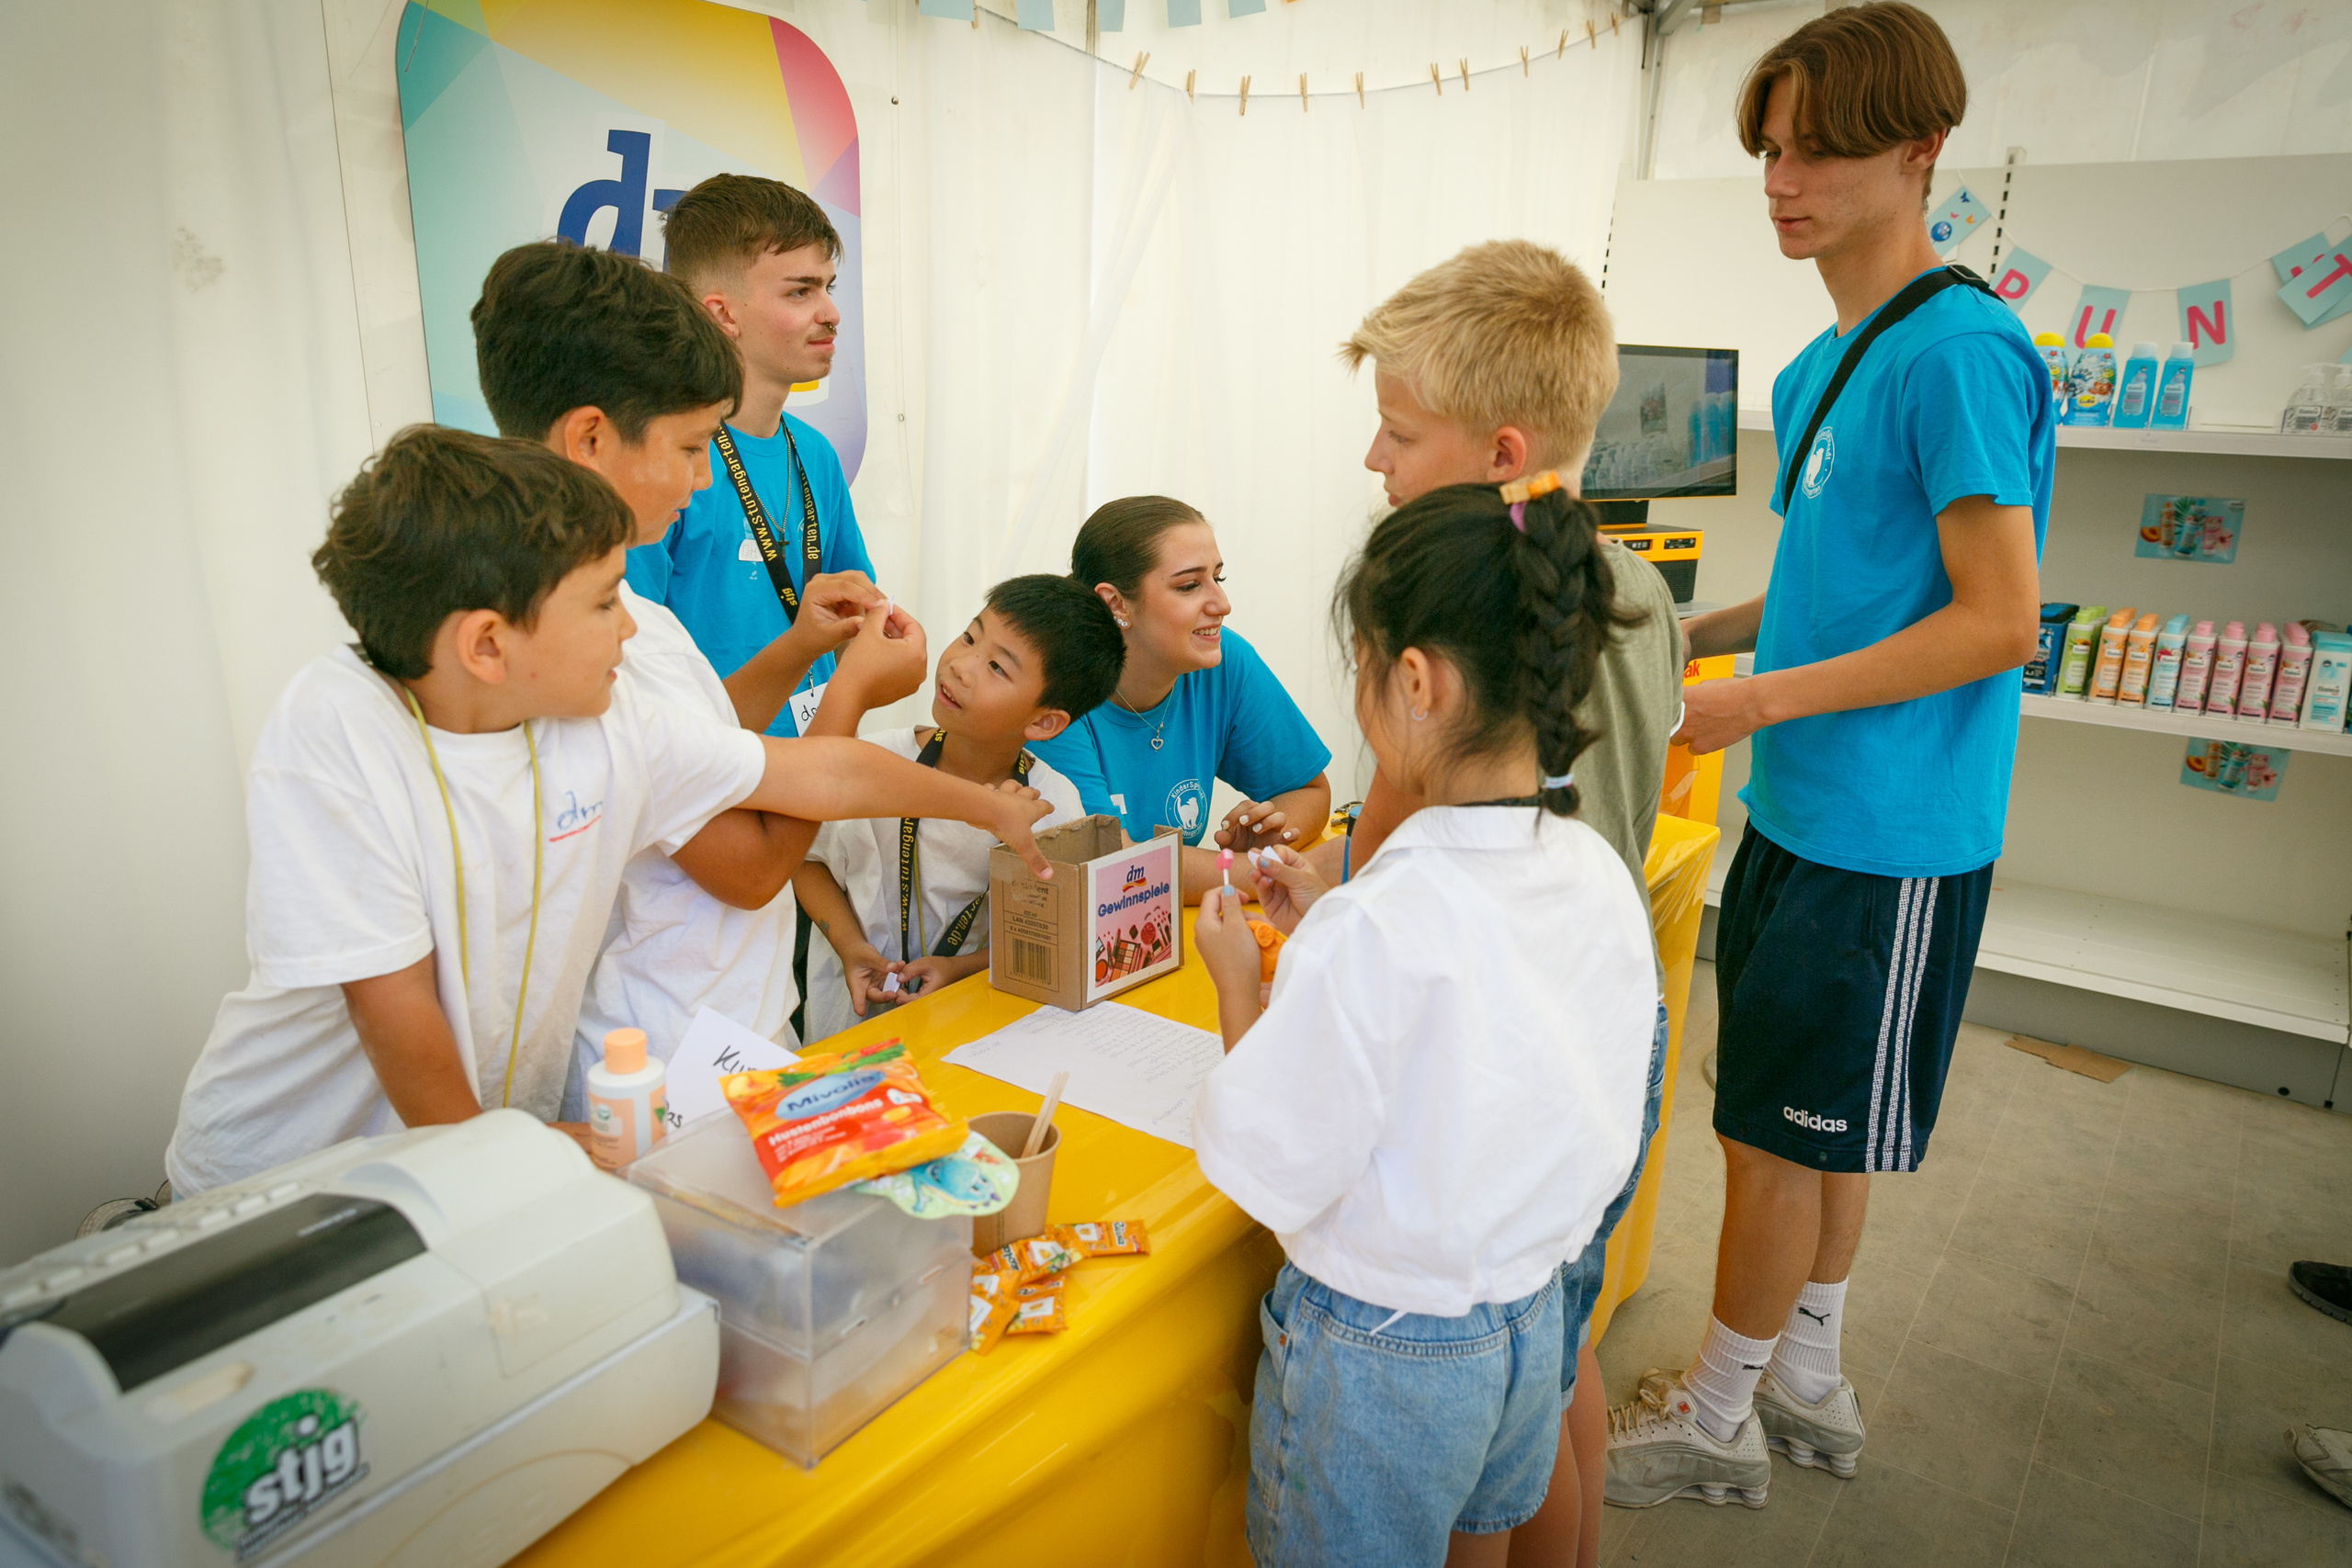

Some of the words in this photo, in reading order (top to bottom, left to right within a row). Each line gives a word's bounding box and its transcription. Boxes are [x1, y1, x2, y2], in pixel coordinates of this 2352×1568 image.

[718, 426, 777, 561] www.stutengarten.
[1126, 864, 1145, 884] dm
[1098, 882, 1170, 918] Gewinnspiele
[768, 1098, 885, 1147] Hustenbonbons
[1782, 1105, 1848, 1134] adidas
